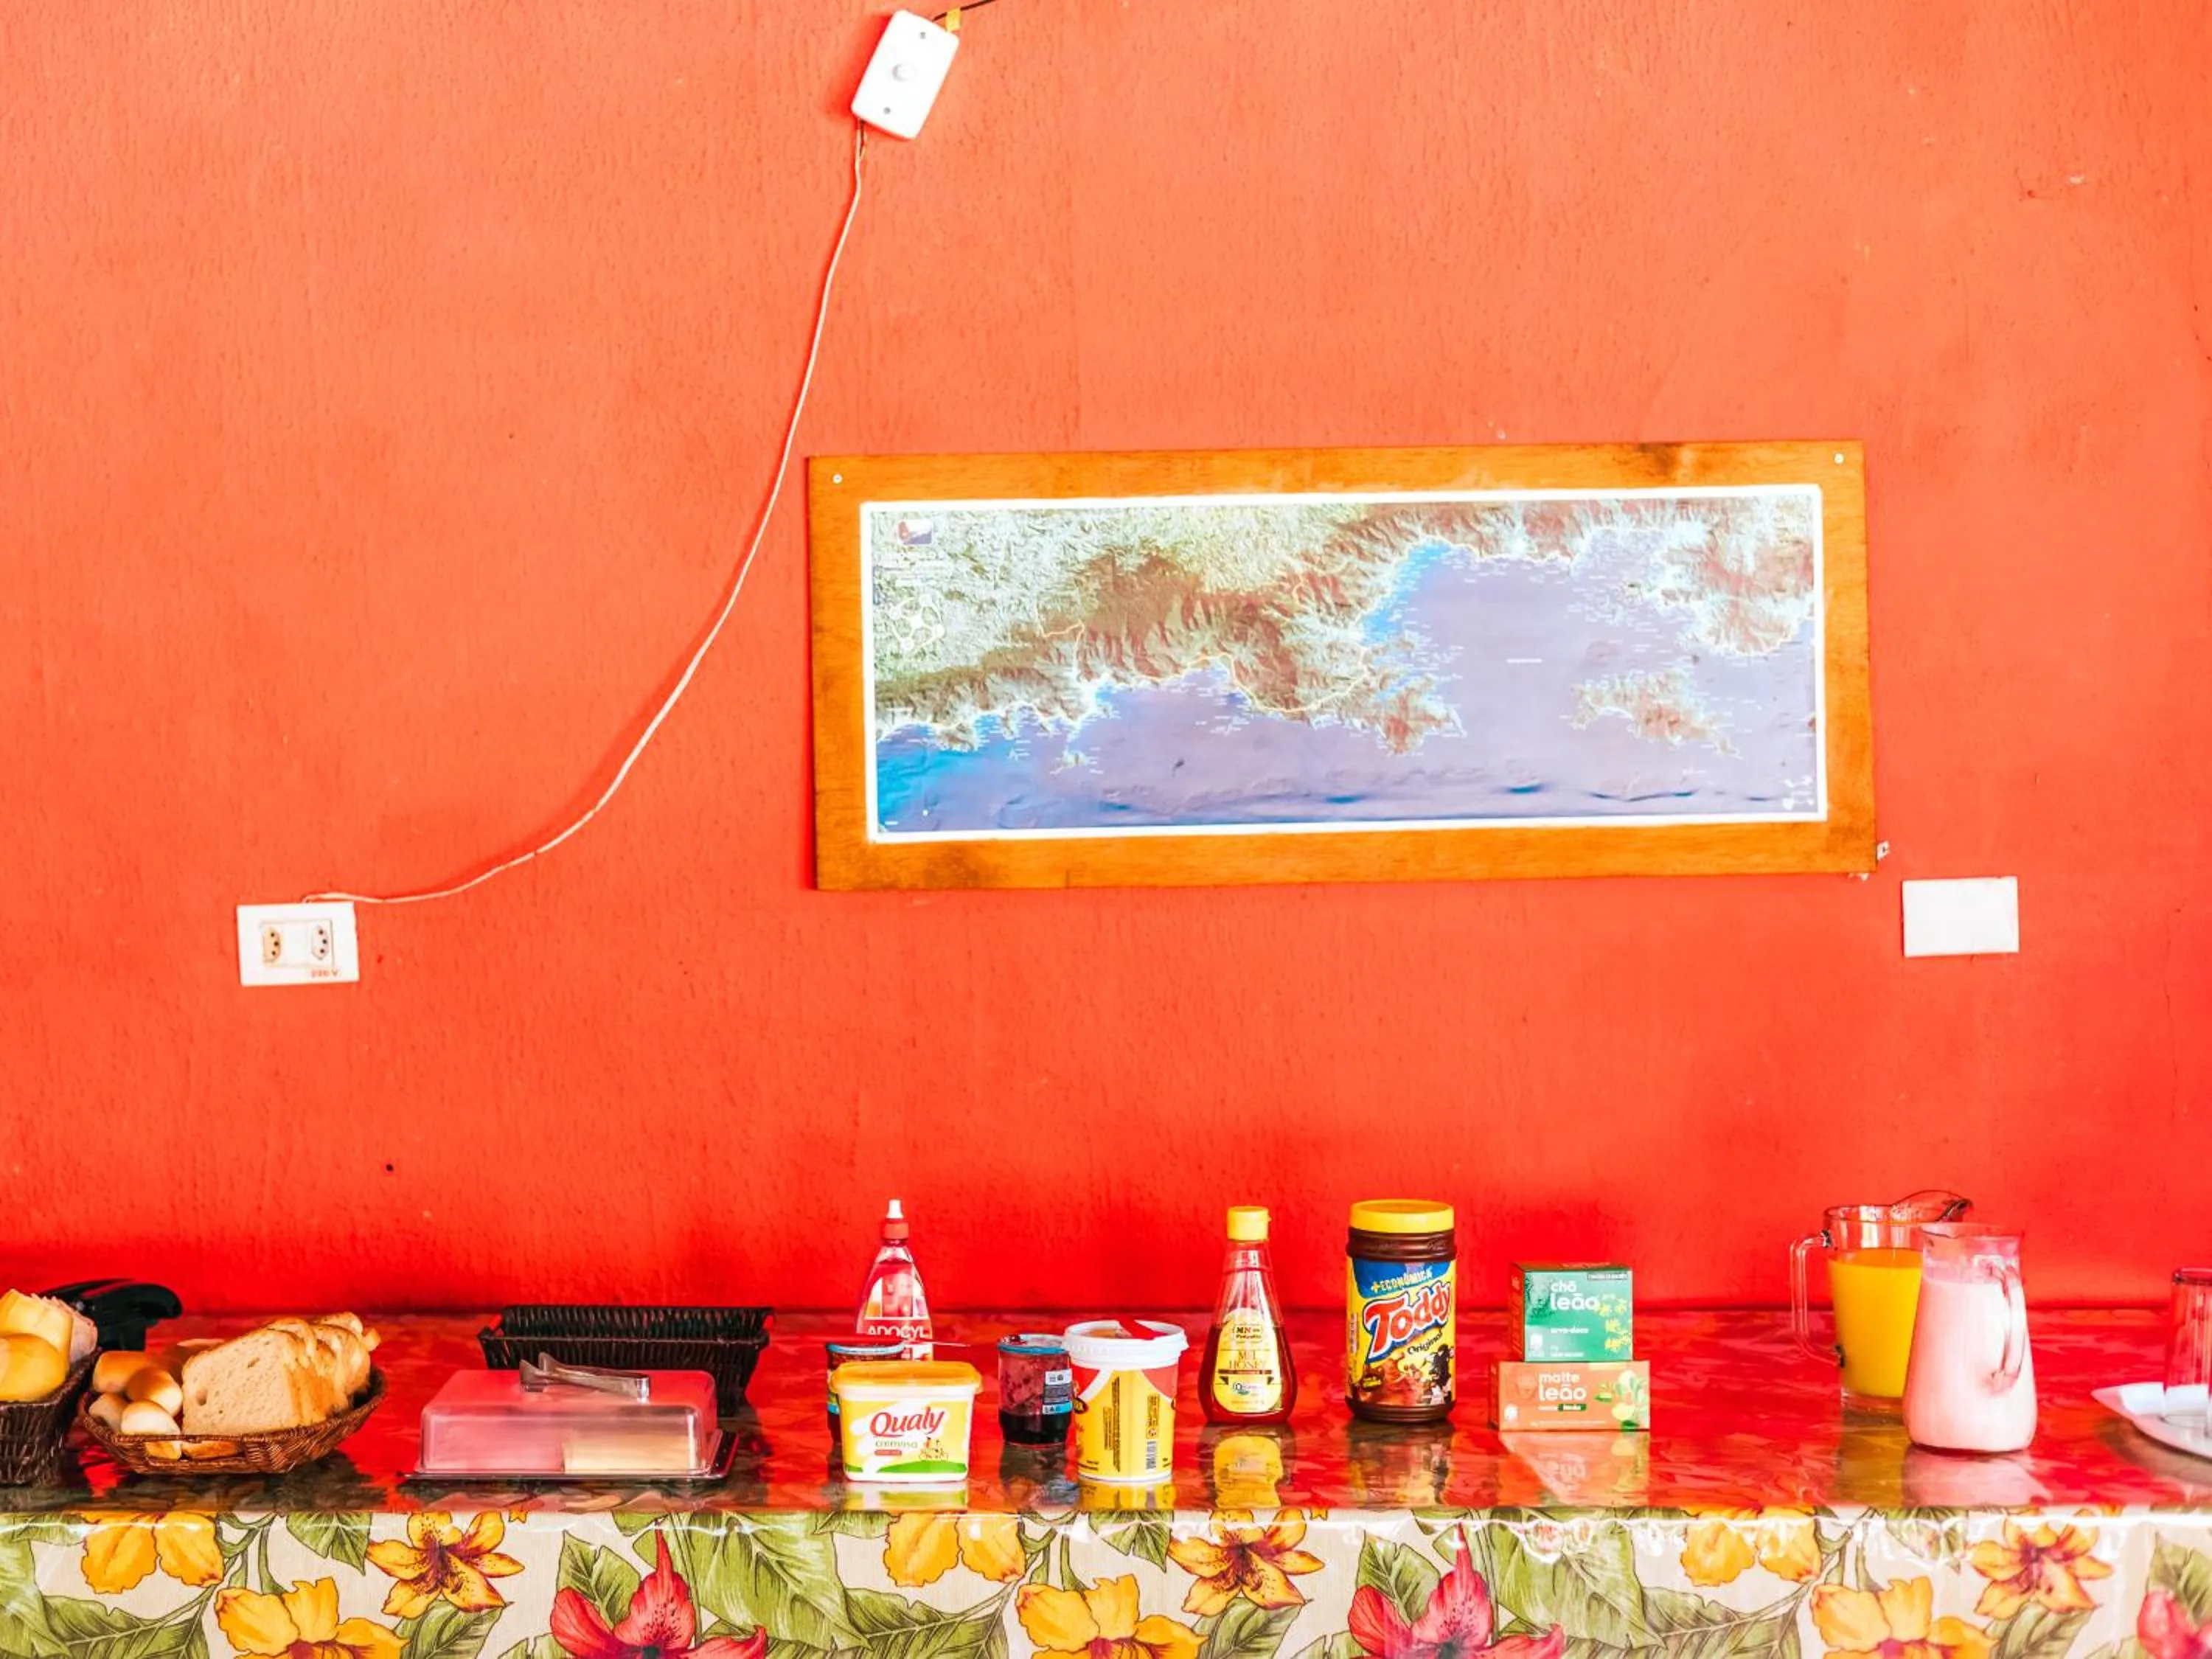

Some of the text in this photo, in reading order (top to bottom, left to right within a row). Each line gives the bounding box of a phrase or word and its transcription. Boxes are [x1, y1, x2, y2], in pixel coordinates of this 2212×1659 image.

[1550, 1292, 1599, 1311] leão
[1364, 1283, 1451, 1357] Toddy
[1407, 1329, 1444, 1354] Original
[1538, 1383, 1587, 1401] leão
[870, 1405, 945, 1437] Qualy
